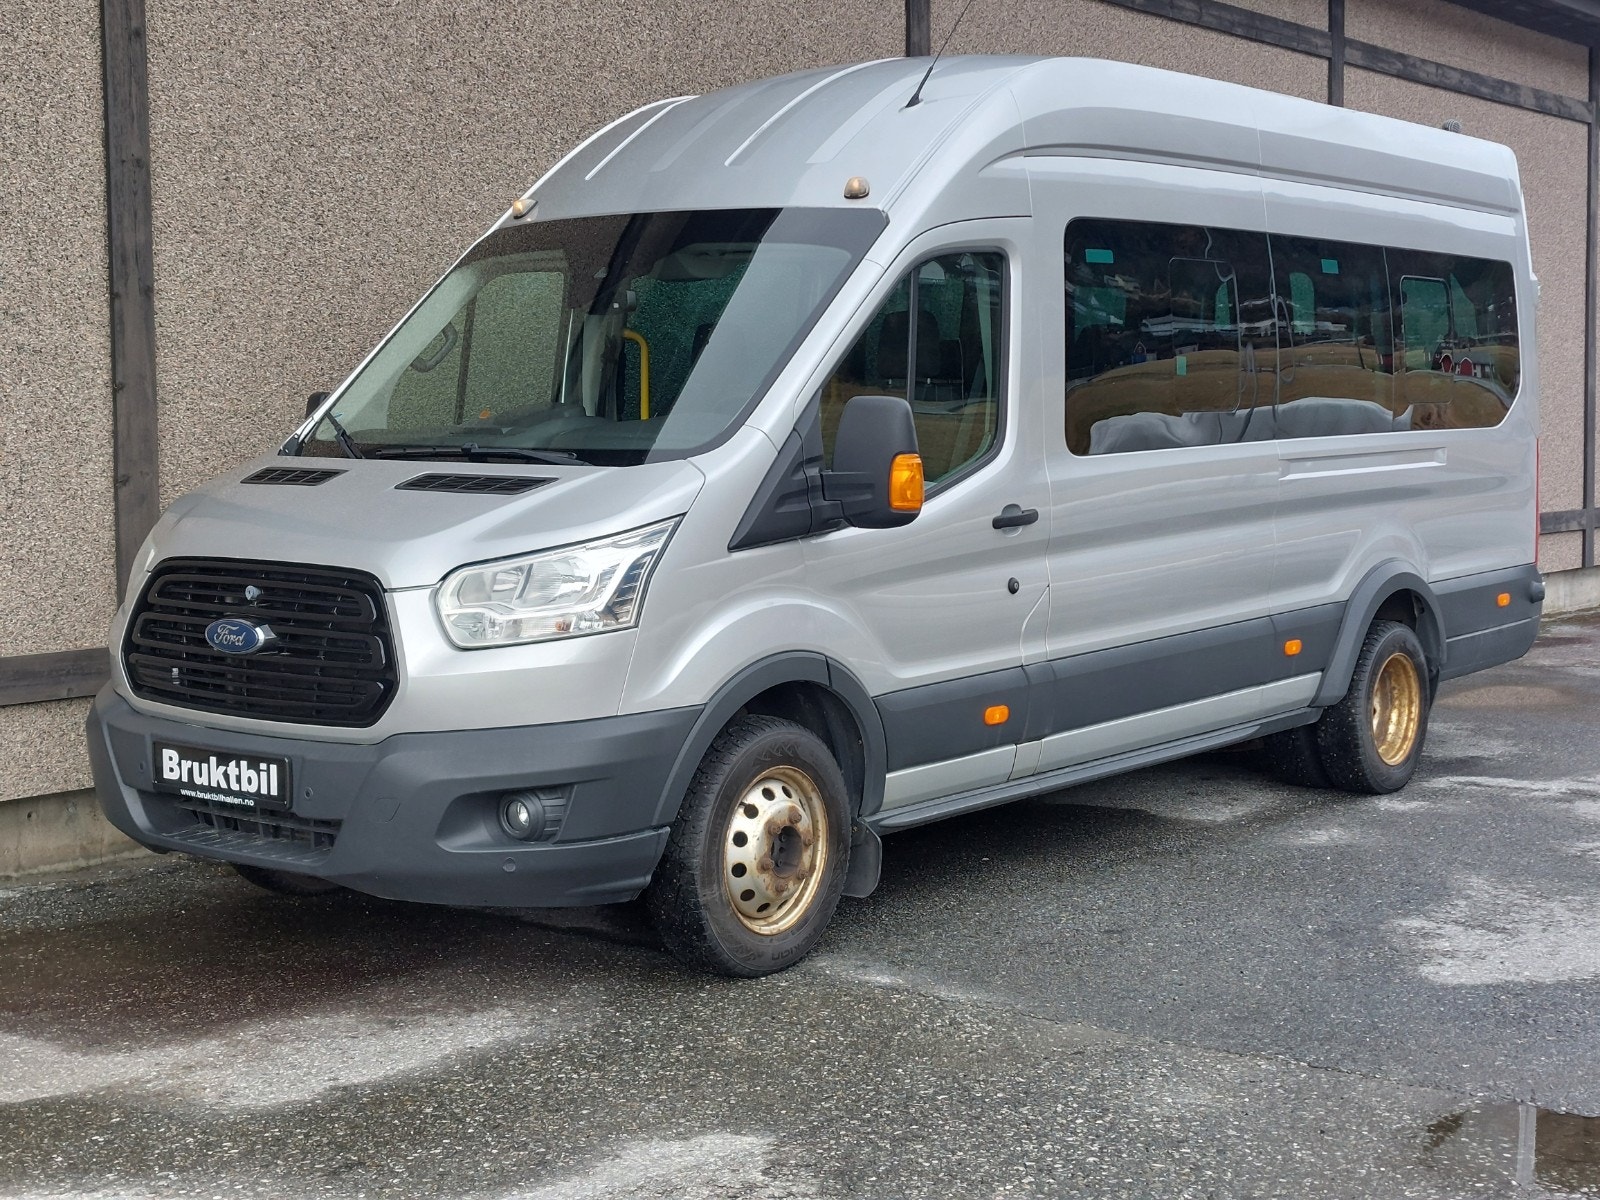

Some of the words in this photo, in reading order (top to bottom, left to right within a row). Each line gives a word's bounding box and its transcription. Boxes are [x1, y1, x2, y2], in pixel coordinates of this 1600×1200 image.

[214, 624, 246, 646] Ford
[162, 748, 278, 796] Bruktbil
[180, 788, 255, 807] www.bruktbilhallen.no
